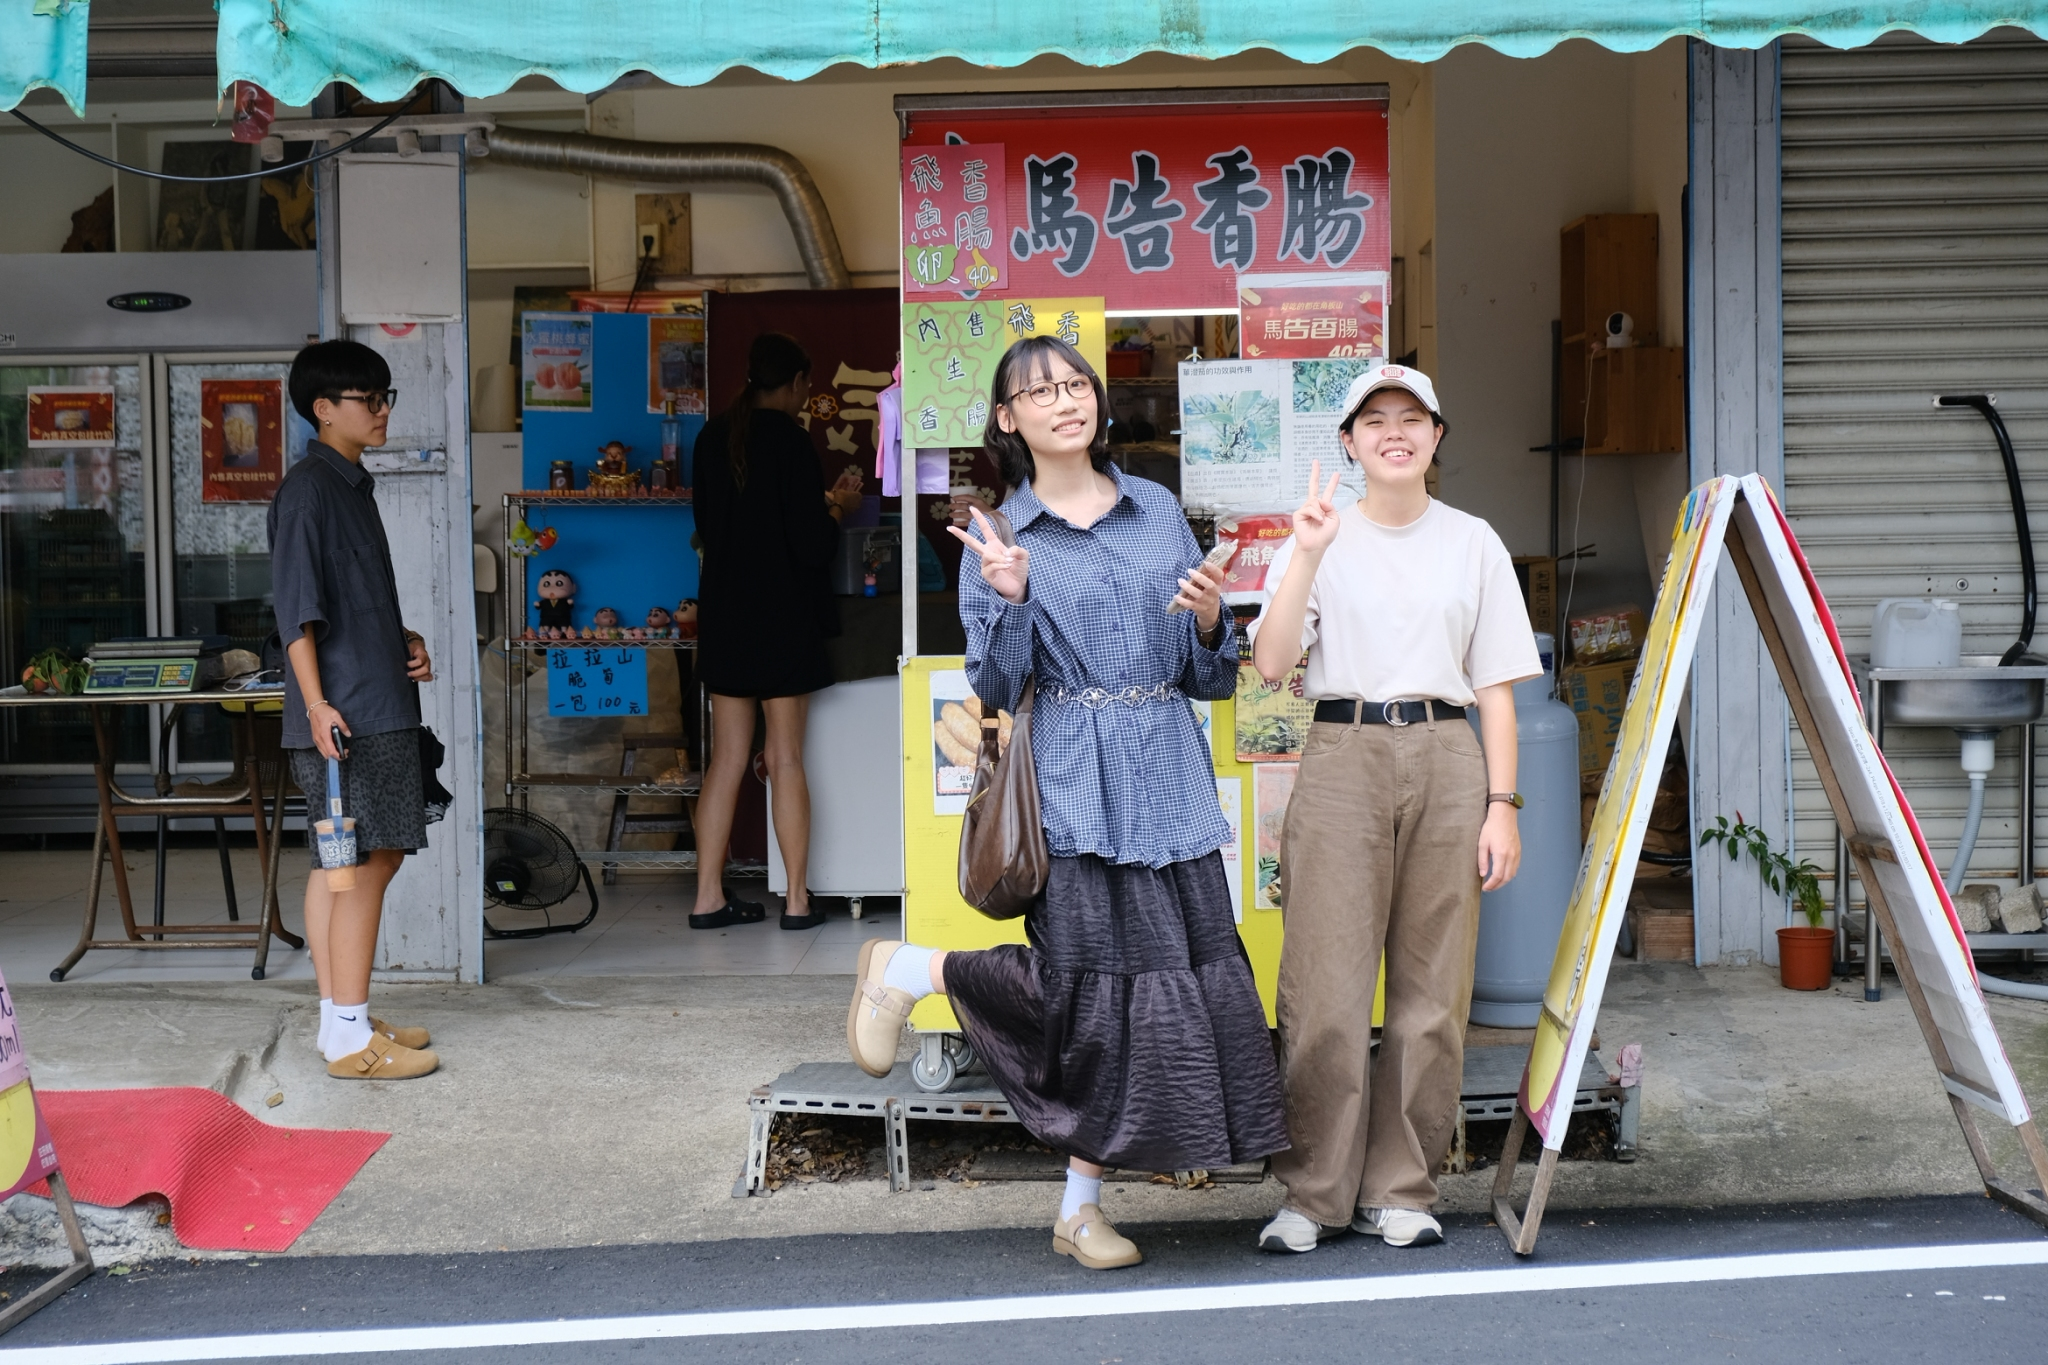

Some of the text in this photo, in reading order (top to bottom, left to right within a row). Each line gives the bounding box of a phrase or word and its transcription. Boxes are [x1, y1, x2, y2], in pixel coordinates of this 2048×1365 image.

[954, 159, 992, 251] 香腸
[1010, 145, 1374, 278] 馬告香腸
[1280, 301, 1343, 312] 好吃的都在角板山
[1008, 303, 1035, 337] 飛
[1263, 317, 1358, 340] 馬告香腸
[525, 331, 590, 346] 水蜜桃蜂蜜
[946, 356, 966, 382] 生
[919, 401, 987, 432] 香腸
[552, 649, 633, 669] 拉拉山
